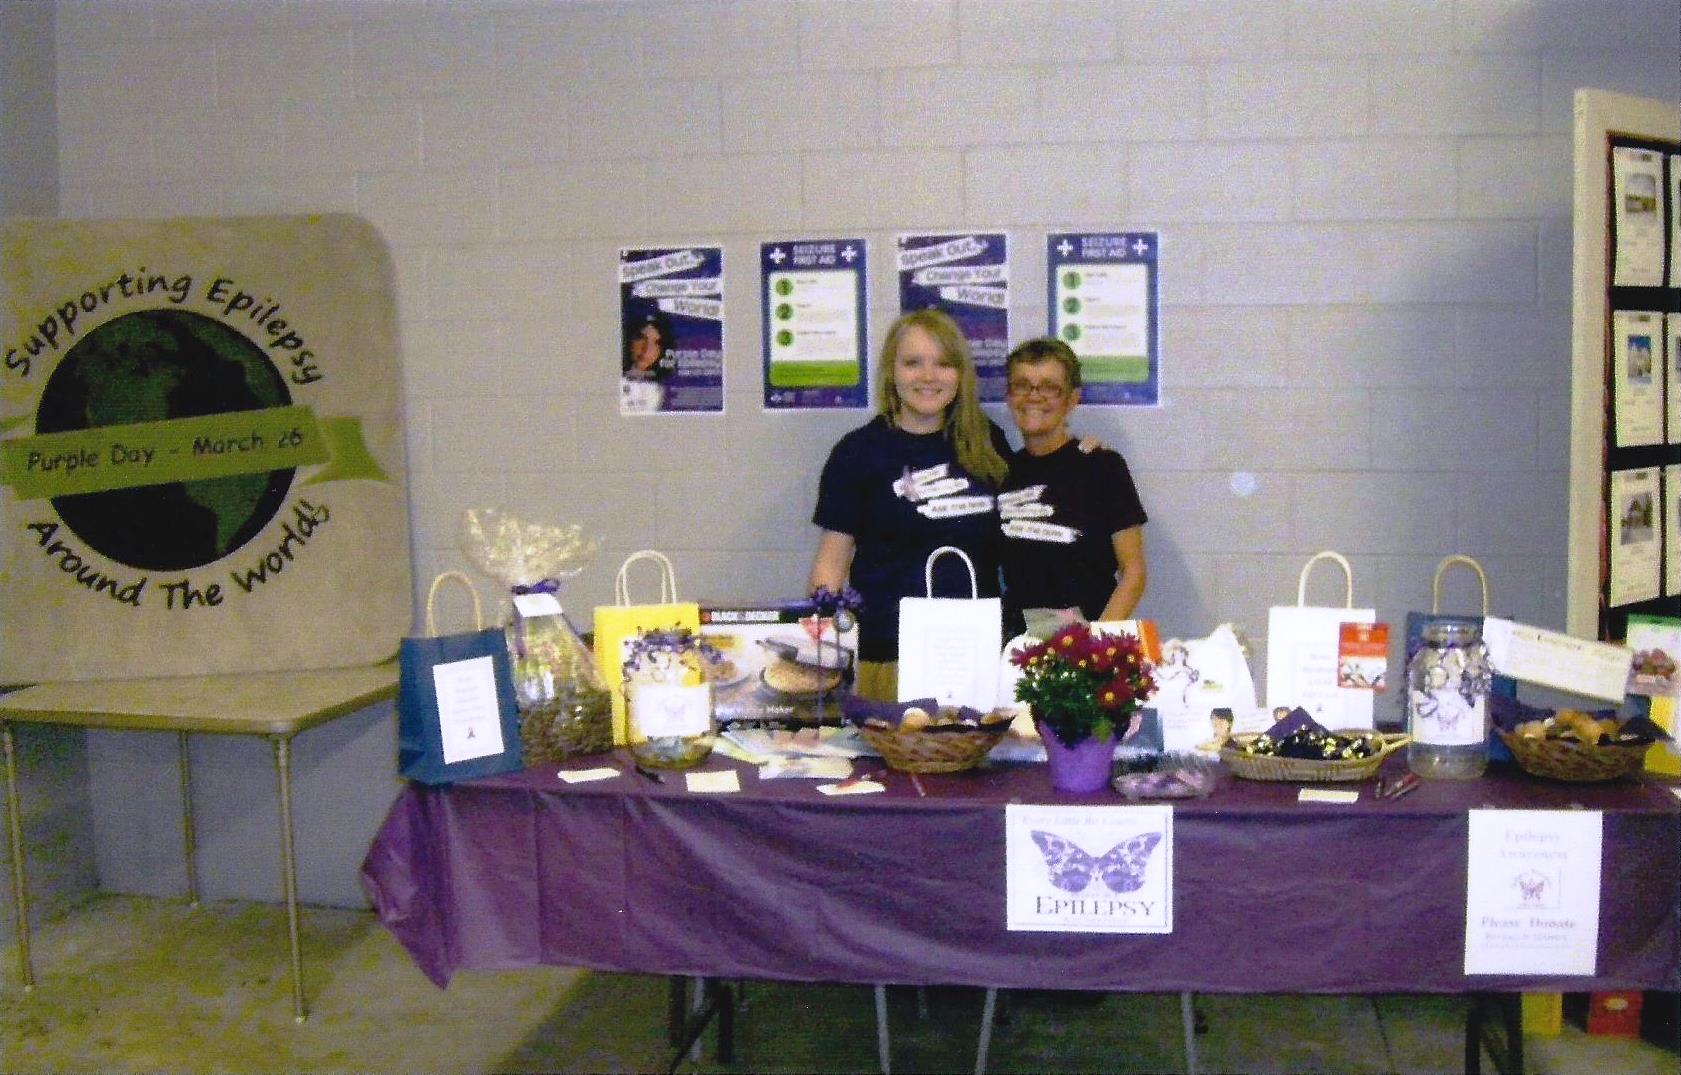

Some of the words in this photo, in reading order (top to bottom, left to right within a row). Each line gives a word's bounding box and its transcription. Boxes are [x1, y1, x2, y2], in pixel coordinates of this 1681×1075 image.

[1081, 237, 1127, 247] SEIZURE
[792, 244, 836, 254] SEIZURE
[1081, 248, 1107, 258] FIRST
[1108, 248, 1127, 258] AID
[792, 255, 817, 265] FIRST
[818, 255, 836, 265] AID
[901, 247, 941, 265] Speak
[622, 261, 662, 278] Speak
[925, 268, 972, 281] Change
[645, 282, 688, 294] Change
[5, 266, 192, 377] Supporting
[206, 277, 324, 385] Epilepsy
[27, 448, 99, 472] Purple
[111, 442, 155, 467] Day
[193, 432, 263, 457] March
[278, 428, 304, 450] 26
[28, 520, 148, 607] Around
[158, 578, 224, 610] The
[766, 705, 796, 714] Maker
[1481, 915, 1520, 929] Please
